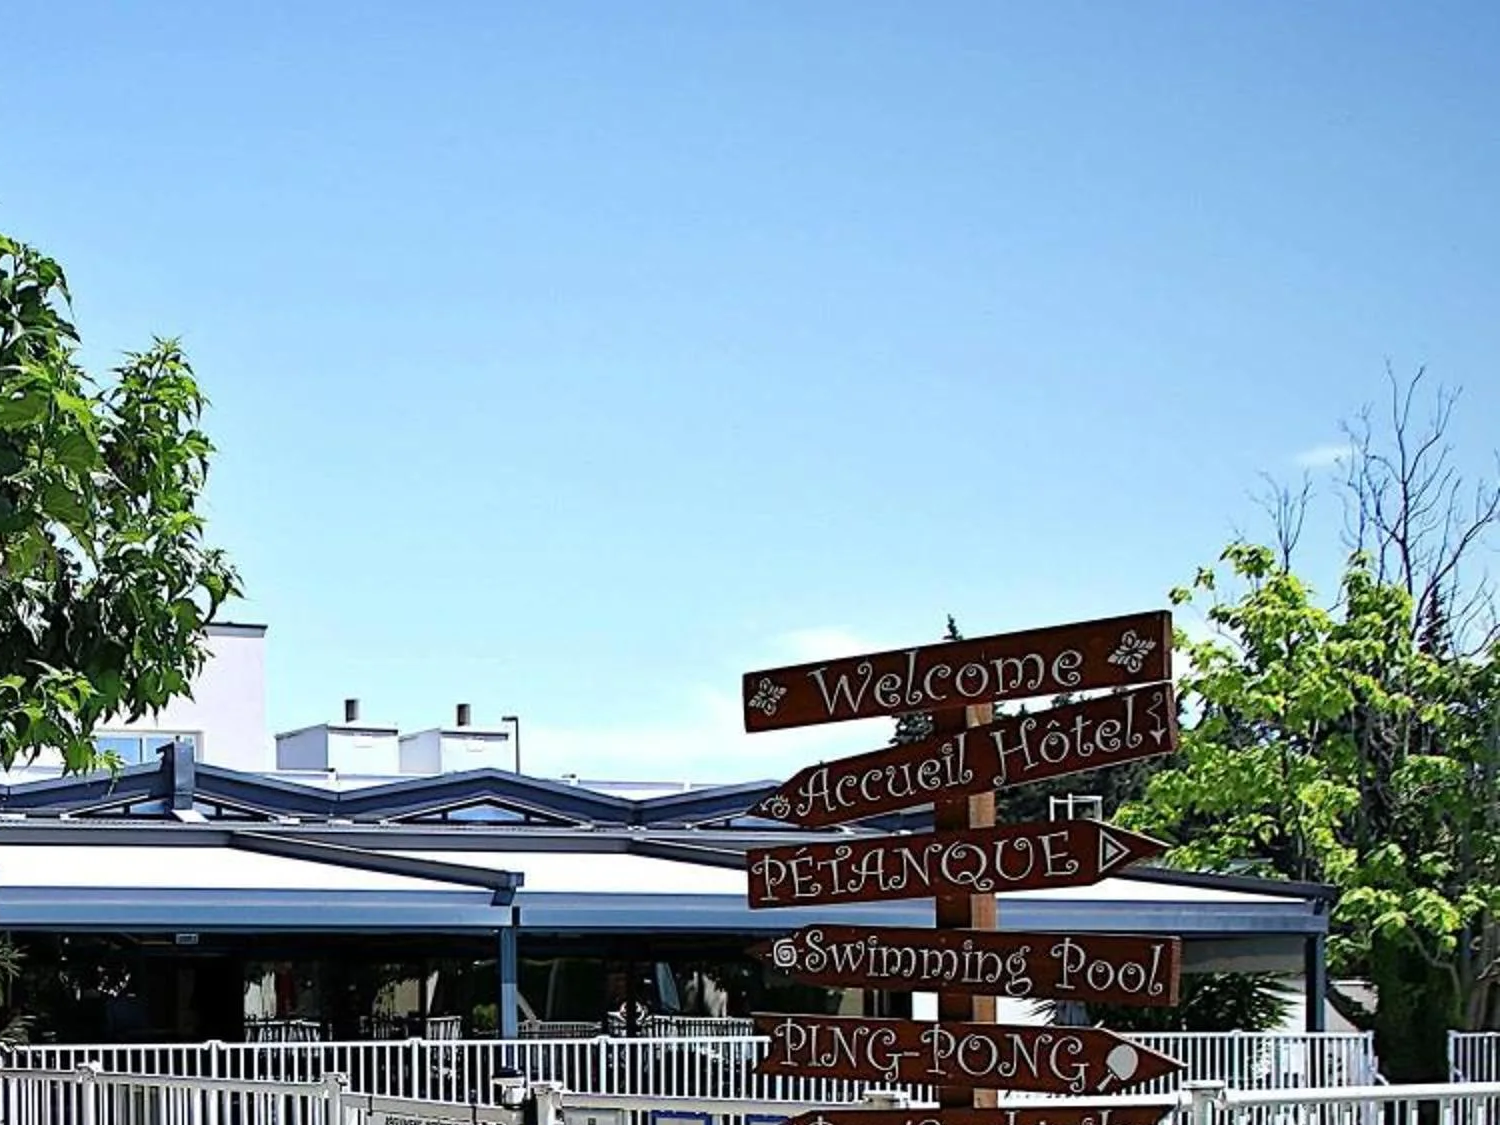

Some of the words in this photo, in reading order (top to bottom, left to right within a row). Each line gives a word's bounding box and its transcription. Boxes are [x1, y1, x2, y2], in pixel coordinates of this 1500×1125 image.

[807, 649, 1084, 716] Welcome
[796, 733, 973, 818] Accueil
[992, 697, 1143, 788] Hôtel
[750, 831, 1080, 900] PÉTANQUE
[804, 929, 1032, 996] Swimming
[1051, 936, 1165, 996] Pool
[773, 1016, 1090, 1092] PING-PONG
